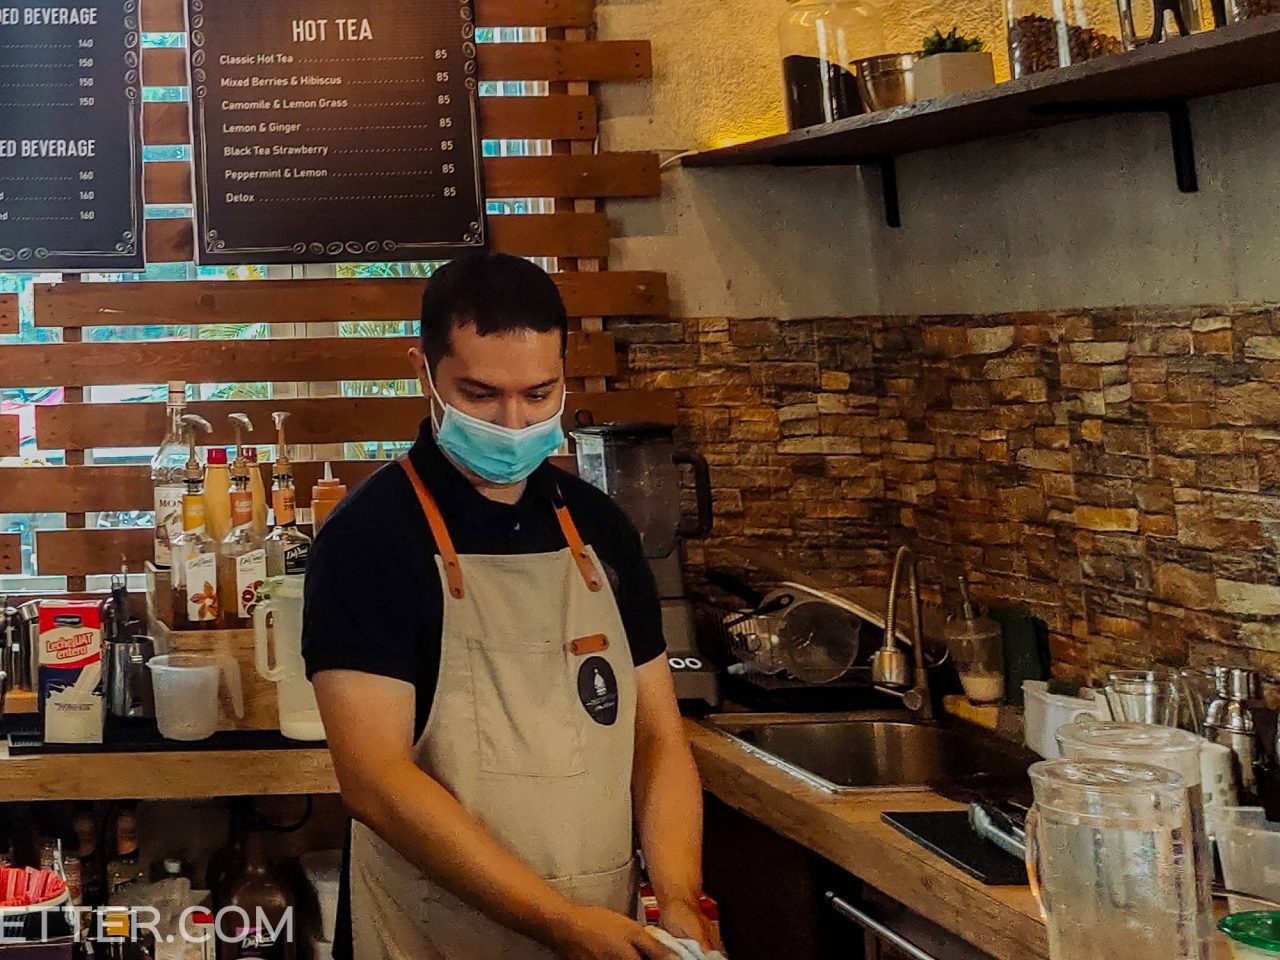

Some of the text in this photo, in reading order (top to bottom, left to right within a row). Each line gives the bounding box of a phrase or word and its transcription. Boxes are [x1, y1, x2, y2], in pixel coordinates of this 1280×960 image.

[23, 7, 98, 25] BEVERAGE
[291, 18, 373, 42] HOT TEA
[77, 39, 94, 49] 140
[78, 58, 94, 68] 150
[219, 49, 448, 65] Classic Hot Tea 85
[78, 77, 94, 87] 150
[220, 72, 449, 88] Mixed Berries & Hibiscus 85
[78, 97, 95, 107] 150
[221, 94, 451, 111] Camomile & Lemon Grass 85
[223, 117, 452, 134] Lemon & Ginger 85
[21, 139, 96, 157] BEVERAGE
[224, 140, 454, 157] Black Tea Strawberry 85
[79, 171, 94, 181] 160
[225, 163, 455, 182] Peppermint & Lemon 85
[79, 191, 95, 201] 160
[226, 186, 457, 203] Detox 85
[79, 211, 95, 220] 160
[46, 632, 94, 653] Leche UAT
